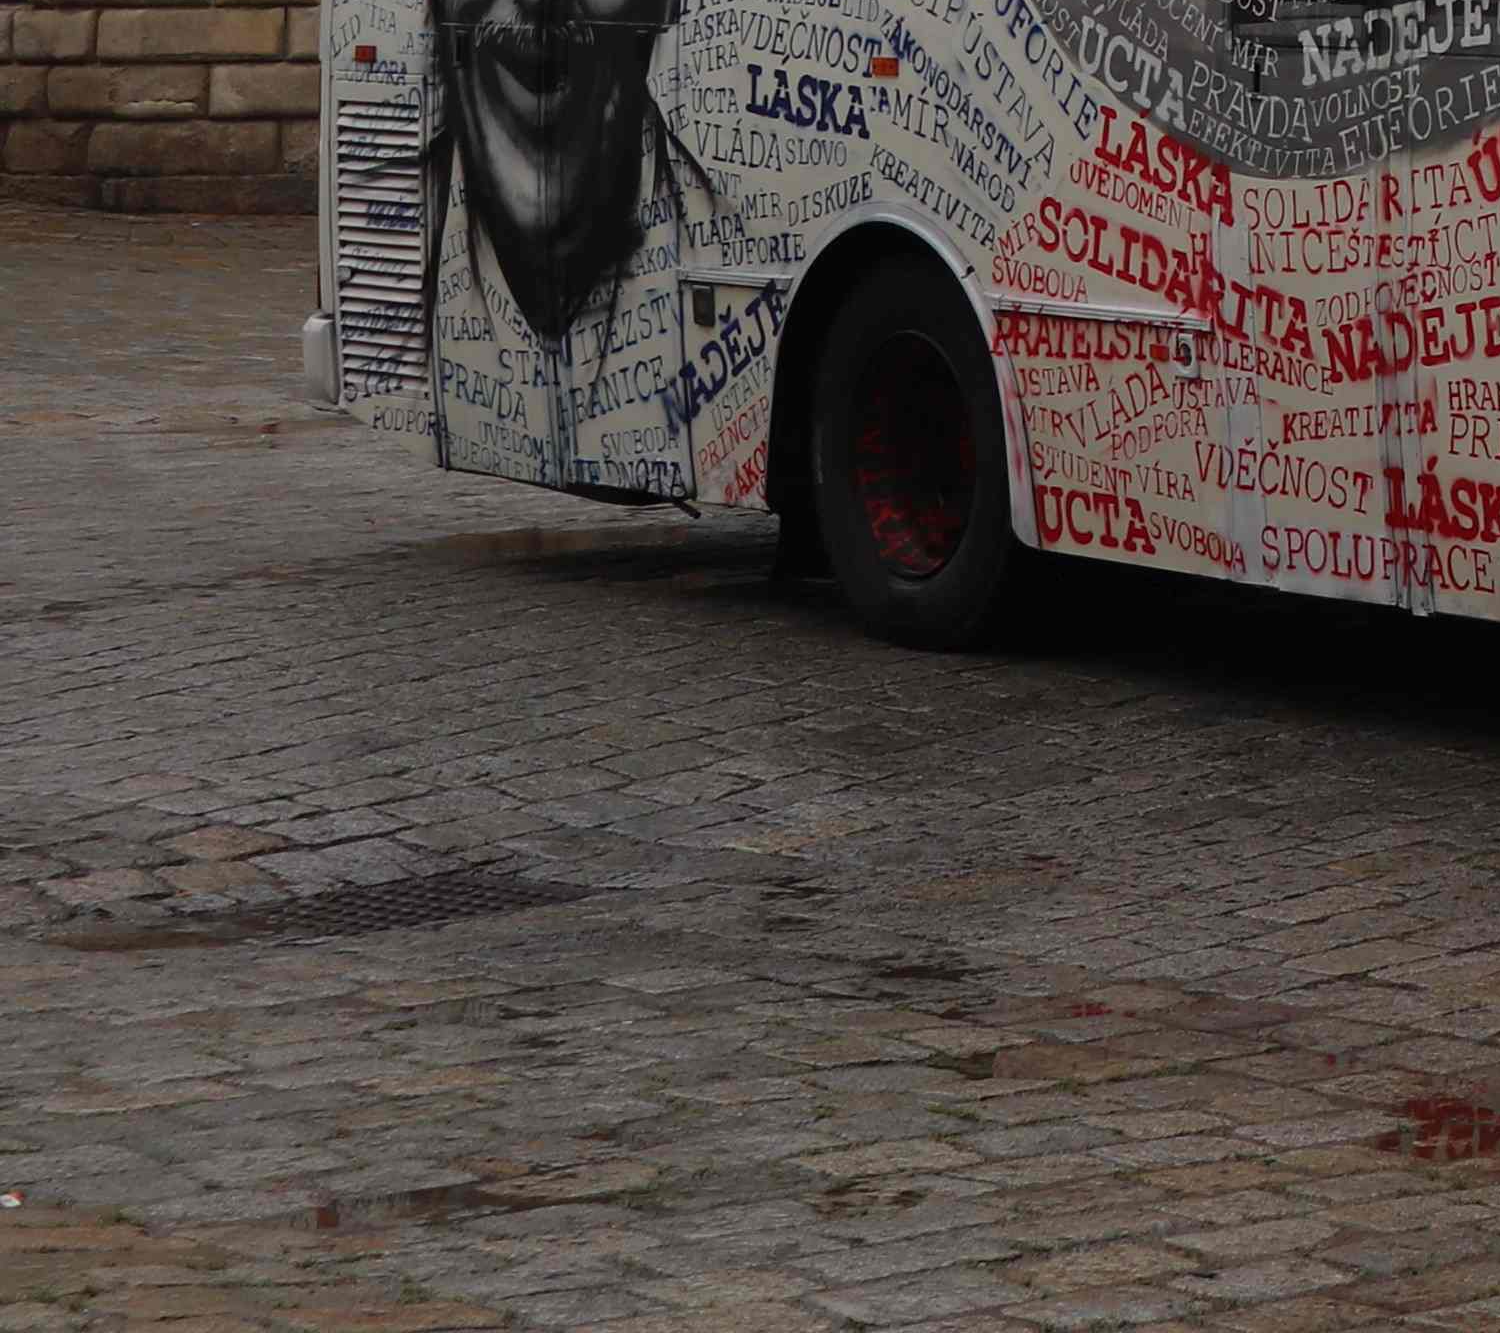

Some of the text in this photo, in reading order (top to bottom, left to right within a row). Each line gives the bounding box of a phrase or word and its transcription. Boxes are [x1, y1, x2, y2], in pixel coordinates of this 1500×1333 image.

[738, 6, 884, 79] VDĚČNOST
[1079, 4, 1188, 128] ÚCTA
[746, 52, 872, 140] LÁSKA
[878, 10, 1034, 192] ZÁKONODÁRSTVÍ
[891, 86, 952, 147] MÍR
[960, 11, 1058, 179] ÚSTAVA
[1188, 60, 1314, 145] PRAVDA
[694, 117, 784, 172] VLÁDA
[784, 138, 849, 169] SLOVO
[948, 134, 1017, 213] NÁROD
[1095, 104, 1235, 228] LÁSKA
[785, 171, 874, 227] DISKUZE
[870, 143, 998, 252] KREATIVITA
[991, 257, 1089, 303] SVOBODA
[1038, 196, 1314, 360] SOLIDARITA
[439, 357, 529, 430] PRAVDA
[1066, 359, 1172, 449] VLÁDA
[1029, 440, 1133, 501] STUDENT
[1109, 406, 1210, 462] PODPORA
[1035, 466, 1158, 556] ÚCTA
[1135, 459, 1197, 503] VÍRA
[1194, 437, 1375, 516] VDĚČNOST
